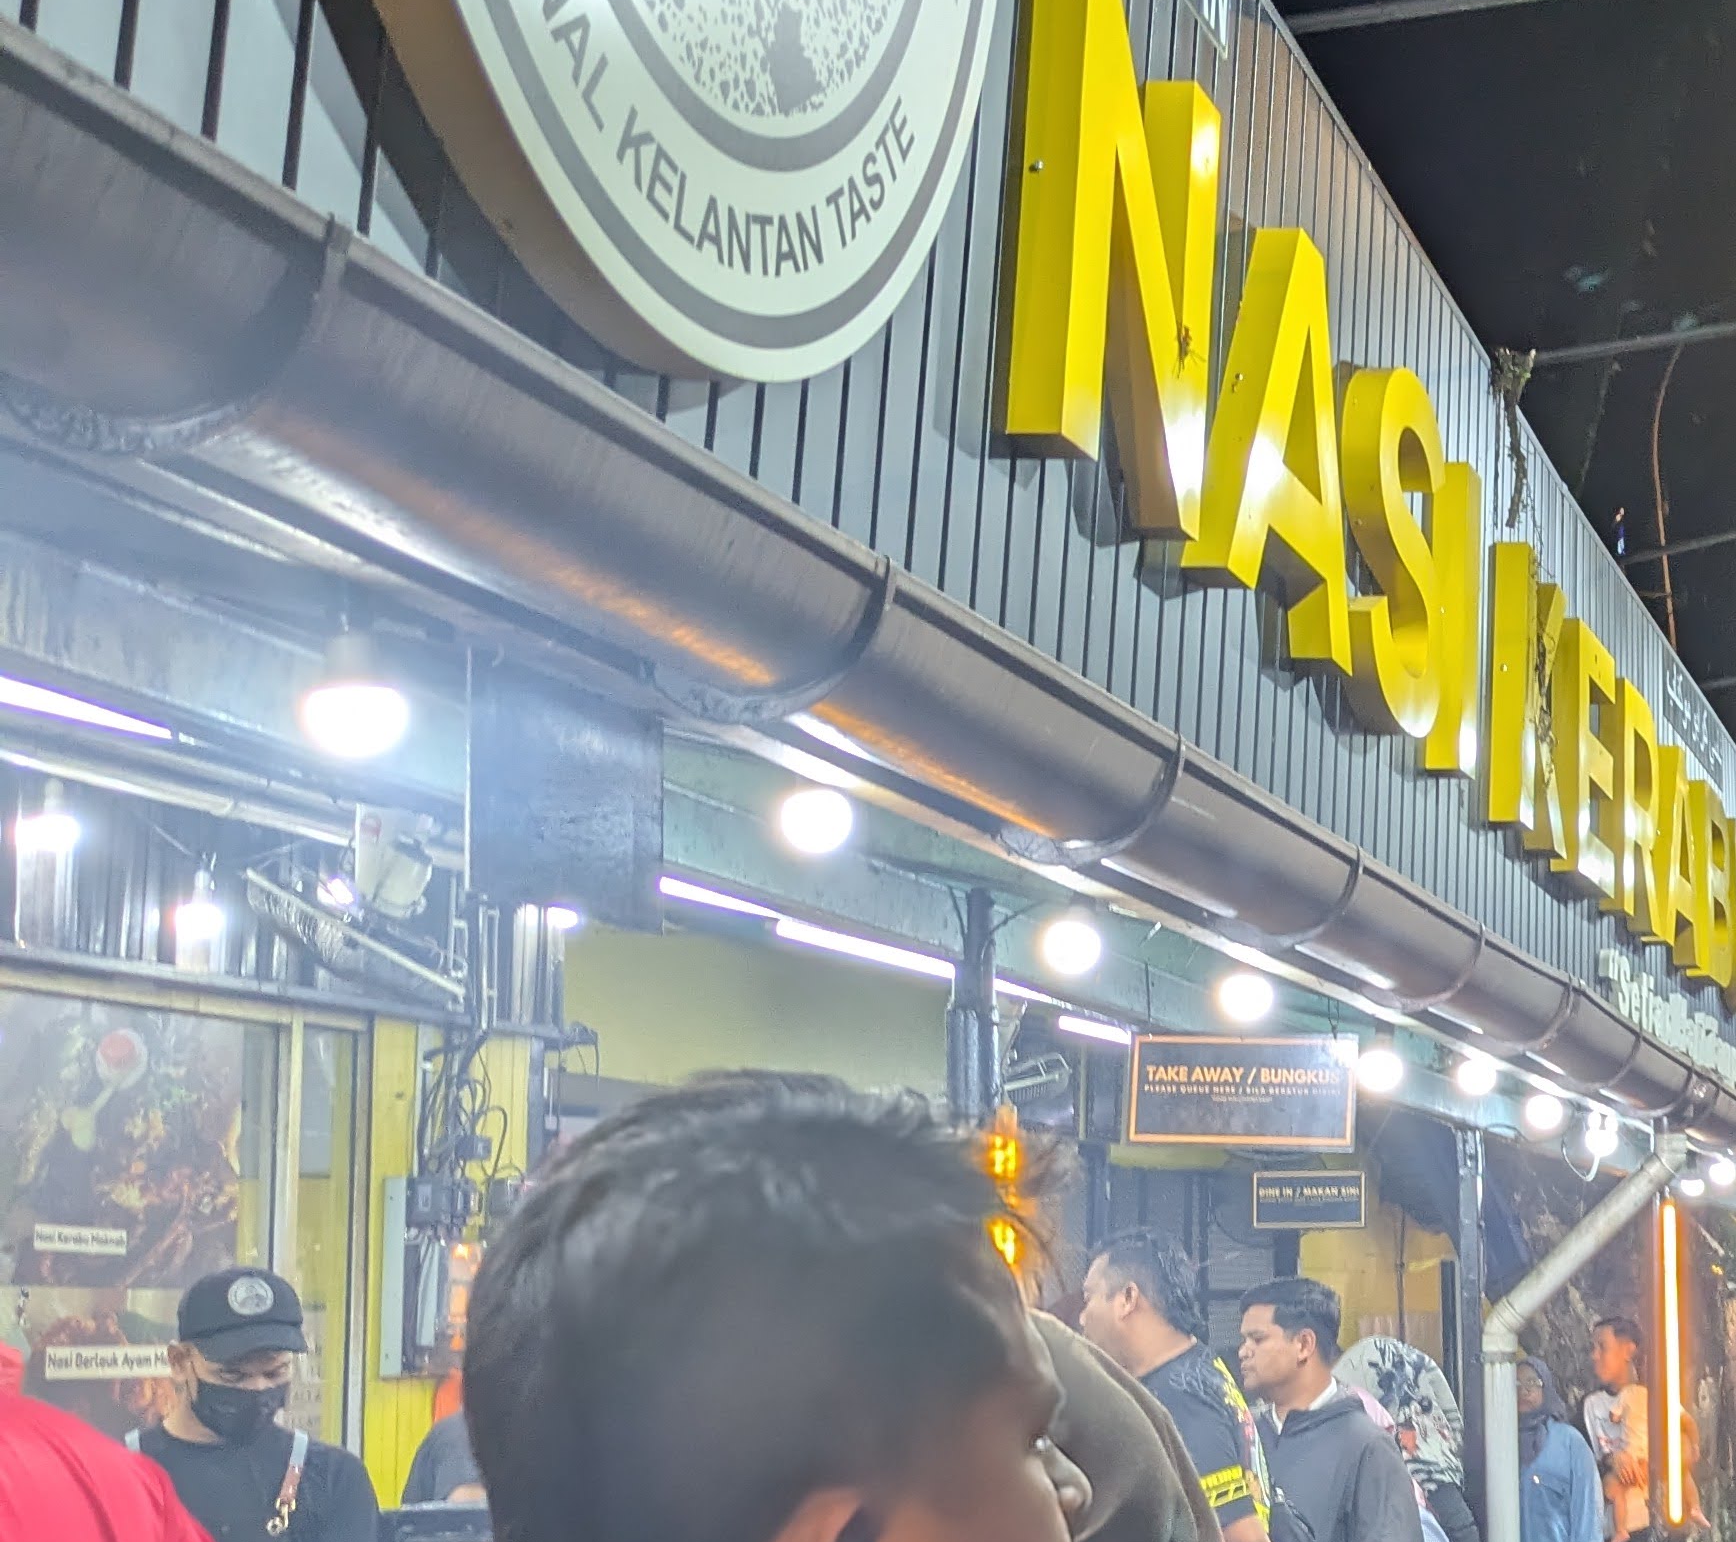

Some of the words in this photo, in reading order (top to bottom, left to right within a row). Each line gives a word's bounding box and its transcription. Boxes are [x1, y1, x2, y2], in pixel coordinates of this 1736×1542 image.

[615, 104, 824, 278] KELANTAN
[825, 95, 918, 249] TASTE
[1146, 1064, 1188, 1082] TAKE
[1190, 1066, 1245, 1083] AWAY
[1246, 1066, 1257, 1085] /
[1259, 1067, 1341, 1085] BUNGKUS
